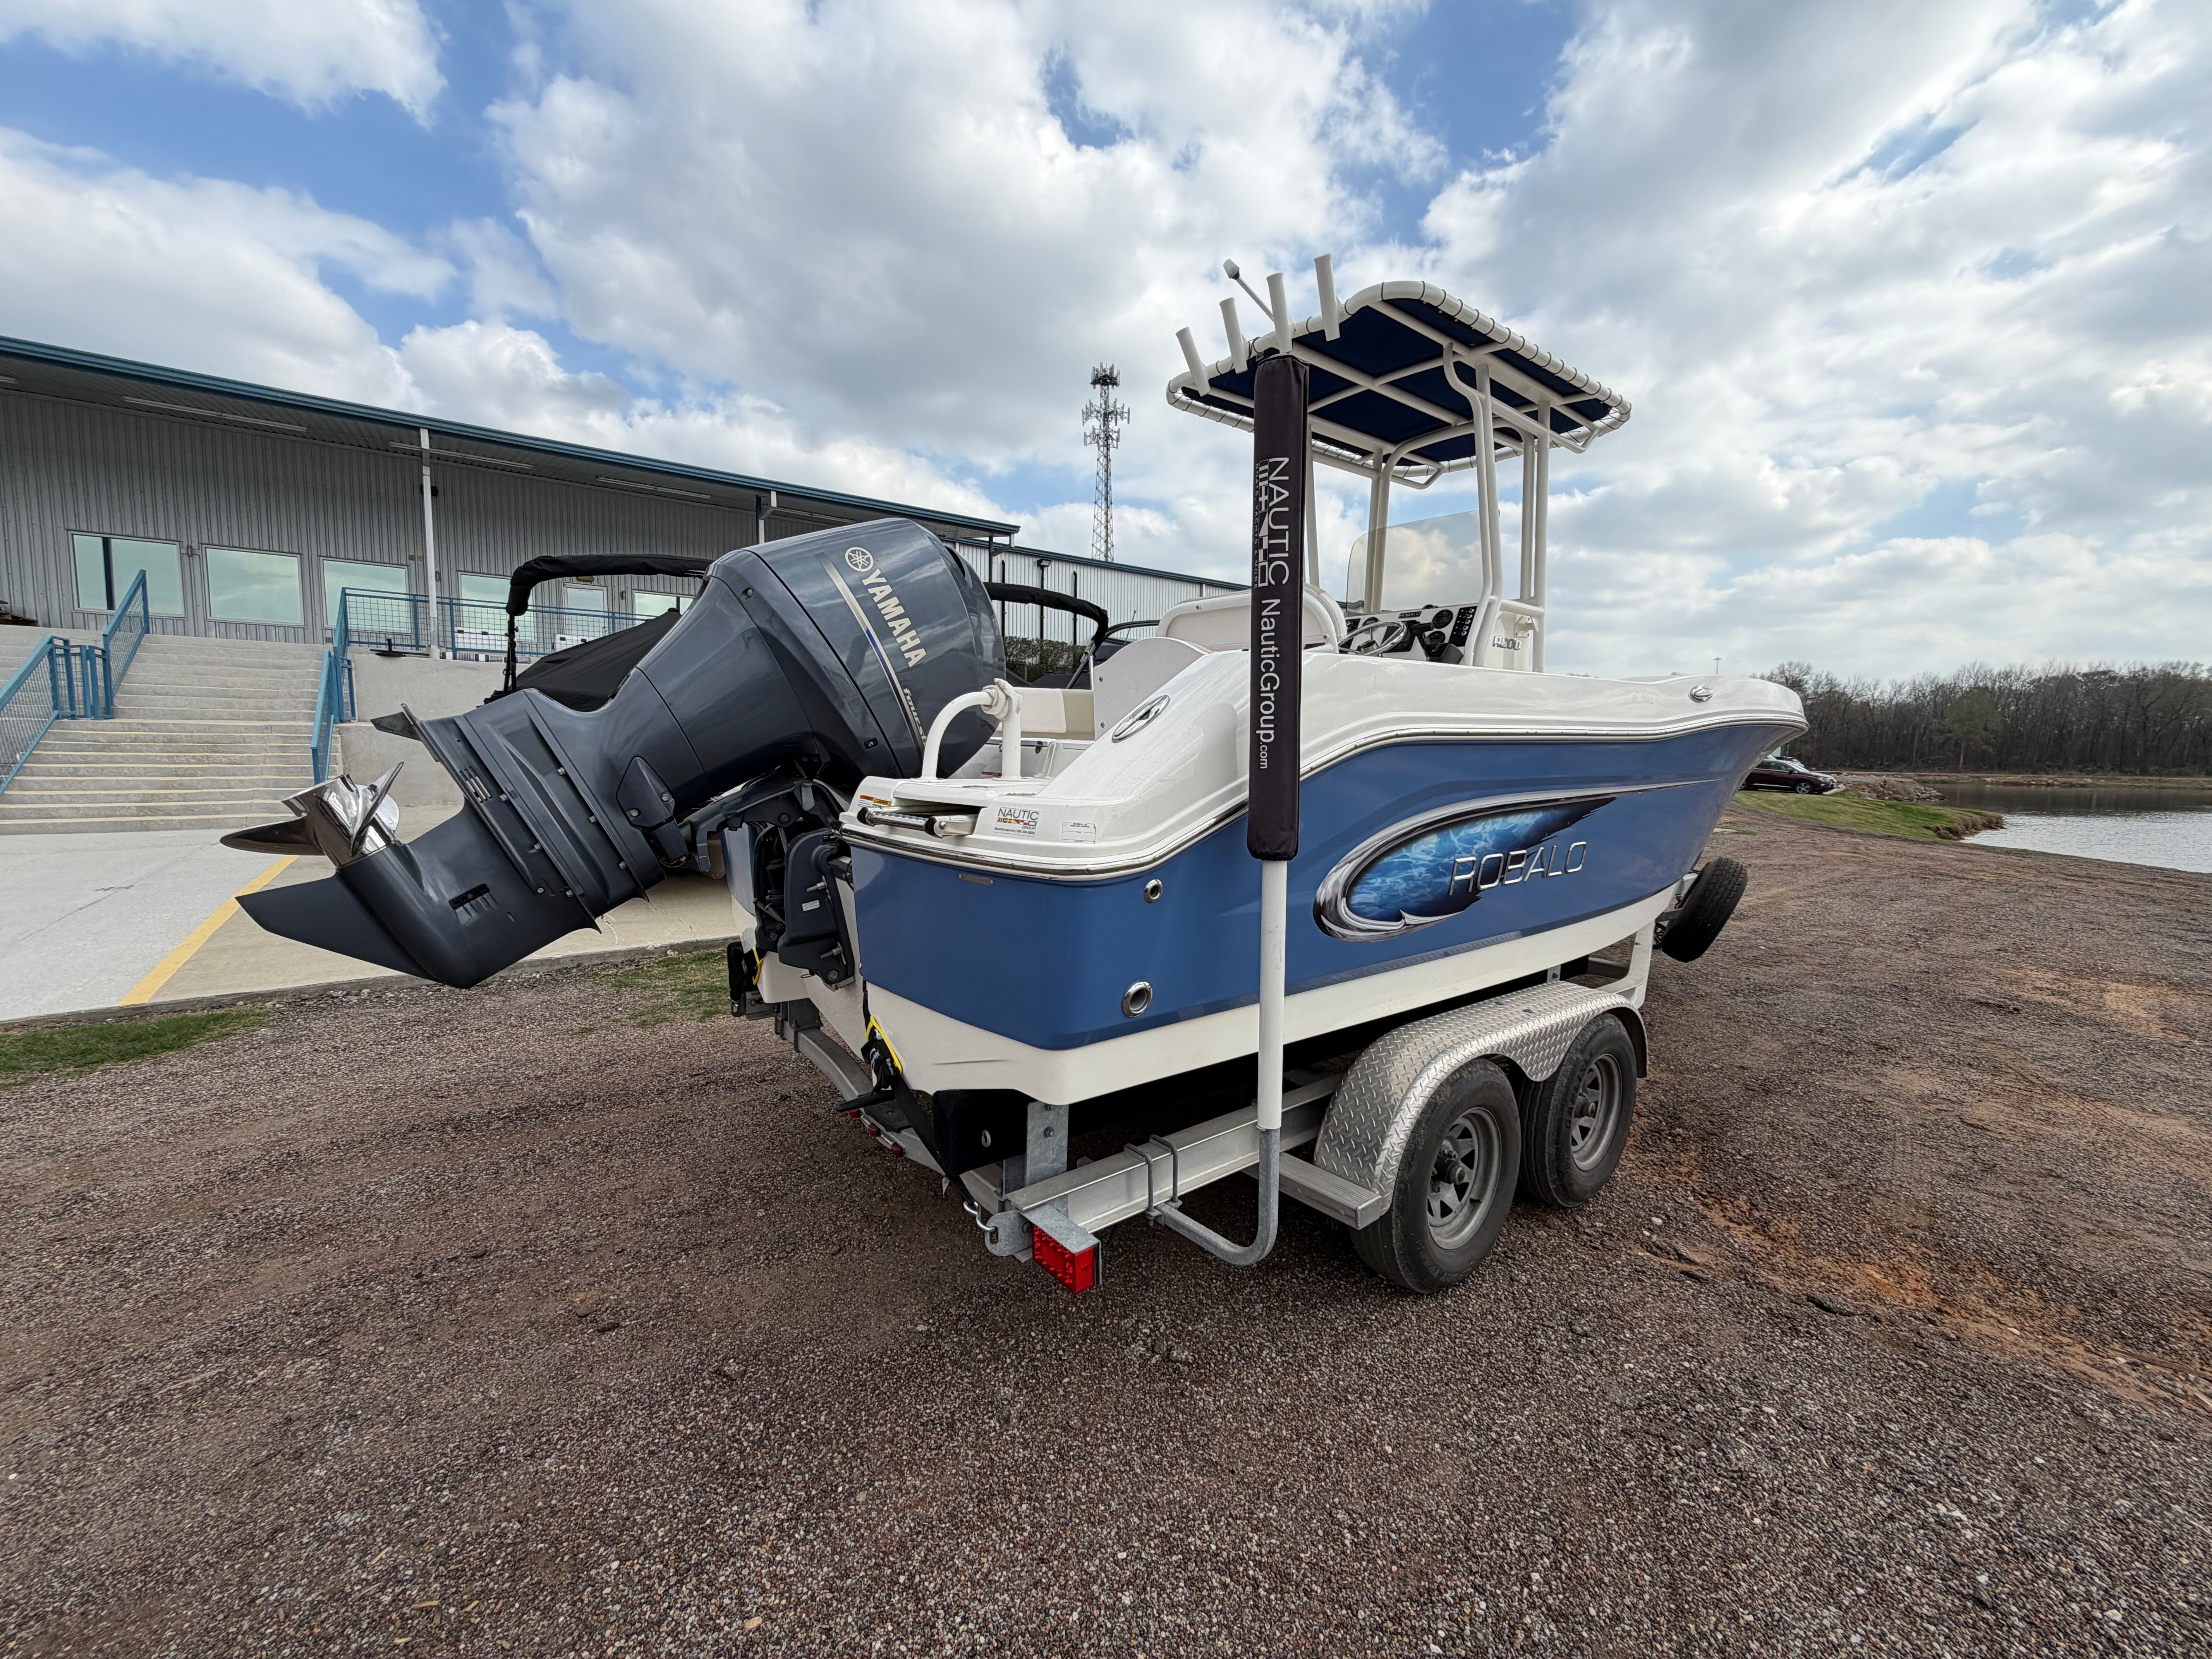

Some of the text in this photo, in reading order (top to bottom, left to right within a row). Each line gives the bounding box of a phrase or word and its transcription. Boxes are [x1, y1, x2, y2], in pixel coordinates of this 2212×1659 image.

[1269, 457, 1289, 586] NAUTIC
[862, 568, 927, 668] YAMAHA
[1492, 636, 1522, 651] R200
[1256, 599, 1280, 769] NauticGroup.com
[998, 808, 1039, 820] NAUTIC
[1448, 841, 1587, 896] ROBALO
